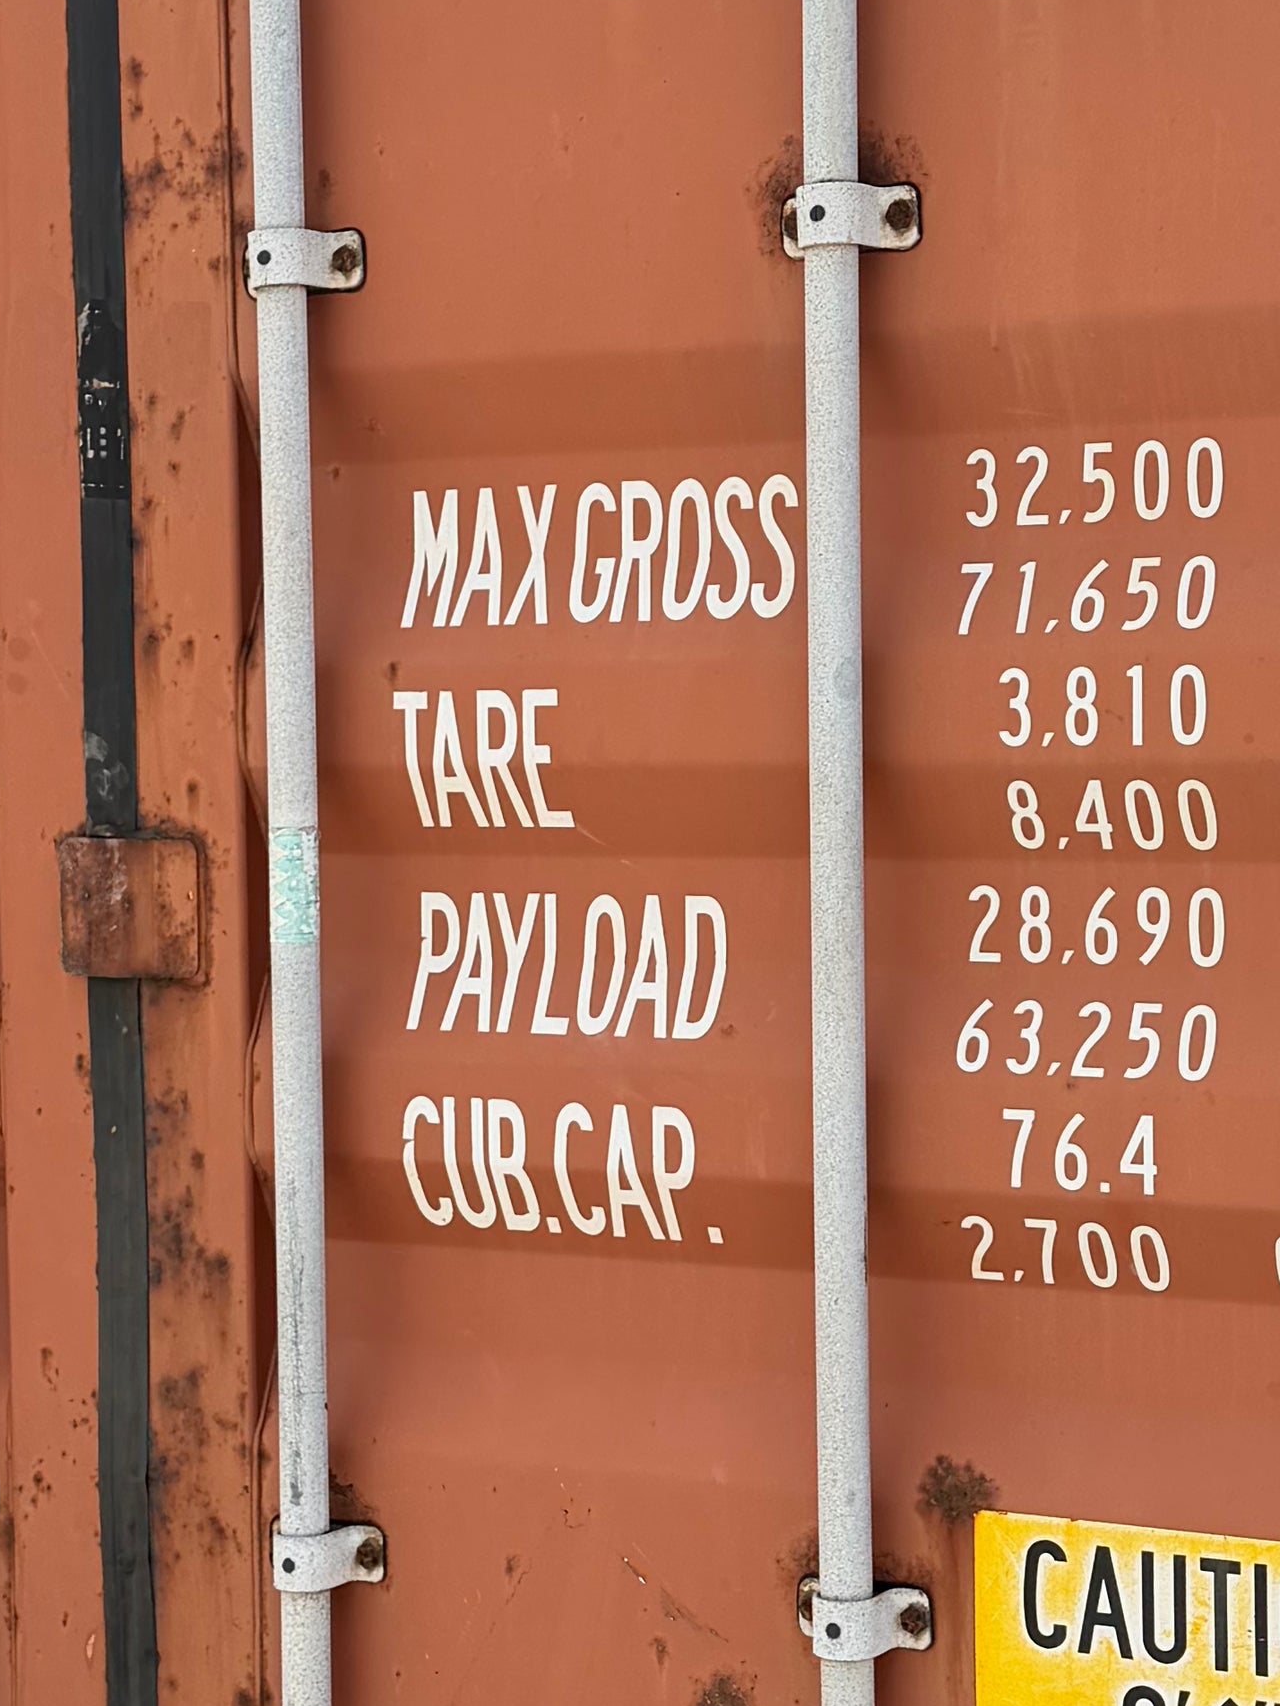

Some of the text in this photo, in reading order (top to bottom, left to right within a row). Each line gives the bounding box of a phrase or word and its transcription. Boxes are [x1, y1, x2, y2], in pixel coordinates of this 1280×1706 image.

[401, 485, 557, 628] MAX
[570, 474, 798, 623] GROSS
[966, 438, 1223, 527] 32,500
[959, 556, 1215, 635] 71,650
[393, 689, 574, 827] TARE
[999, 665, 1206, 746] 3,810
[1007, 780, 1217, 850] 8,400
[406, 892, 726, 1039] PAYLOAD
[969, 885, 1224, 967] 28,690
[957, 999, 1216, 1081] 63,250
[403, 1096, 723, 1243] CUB.CAP.
[1003, 1109, 1157, 1195] 76.4
[961, 1216, 1169, 1291] 2,700
